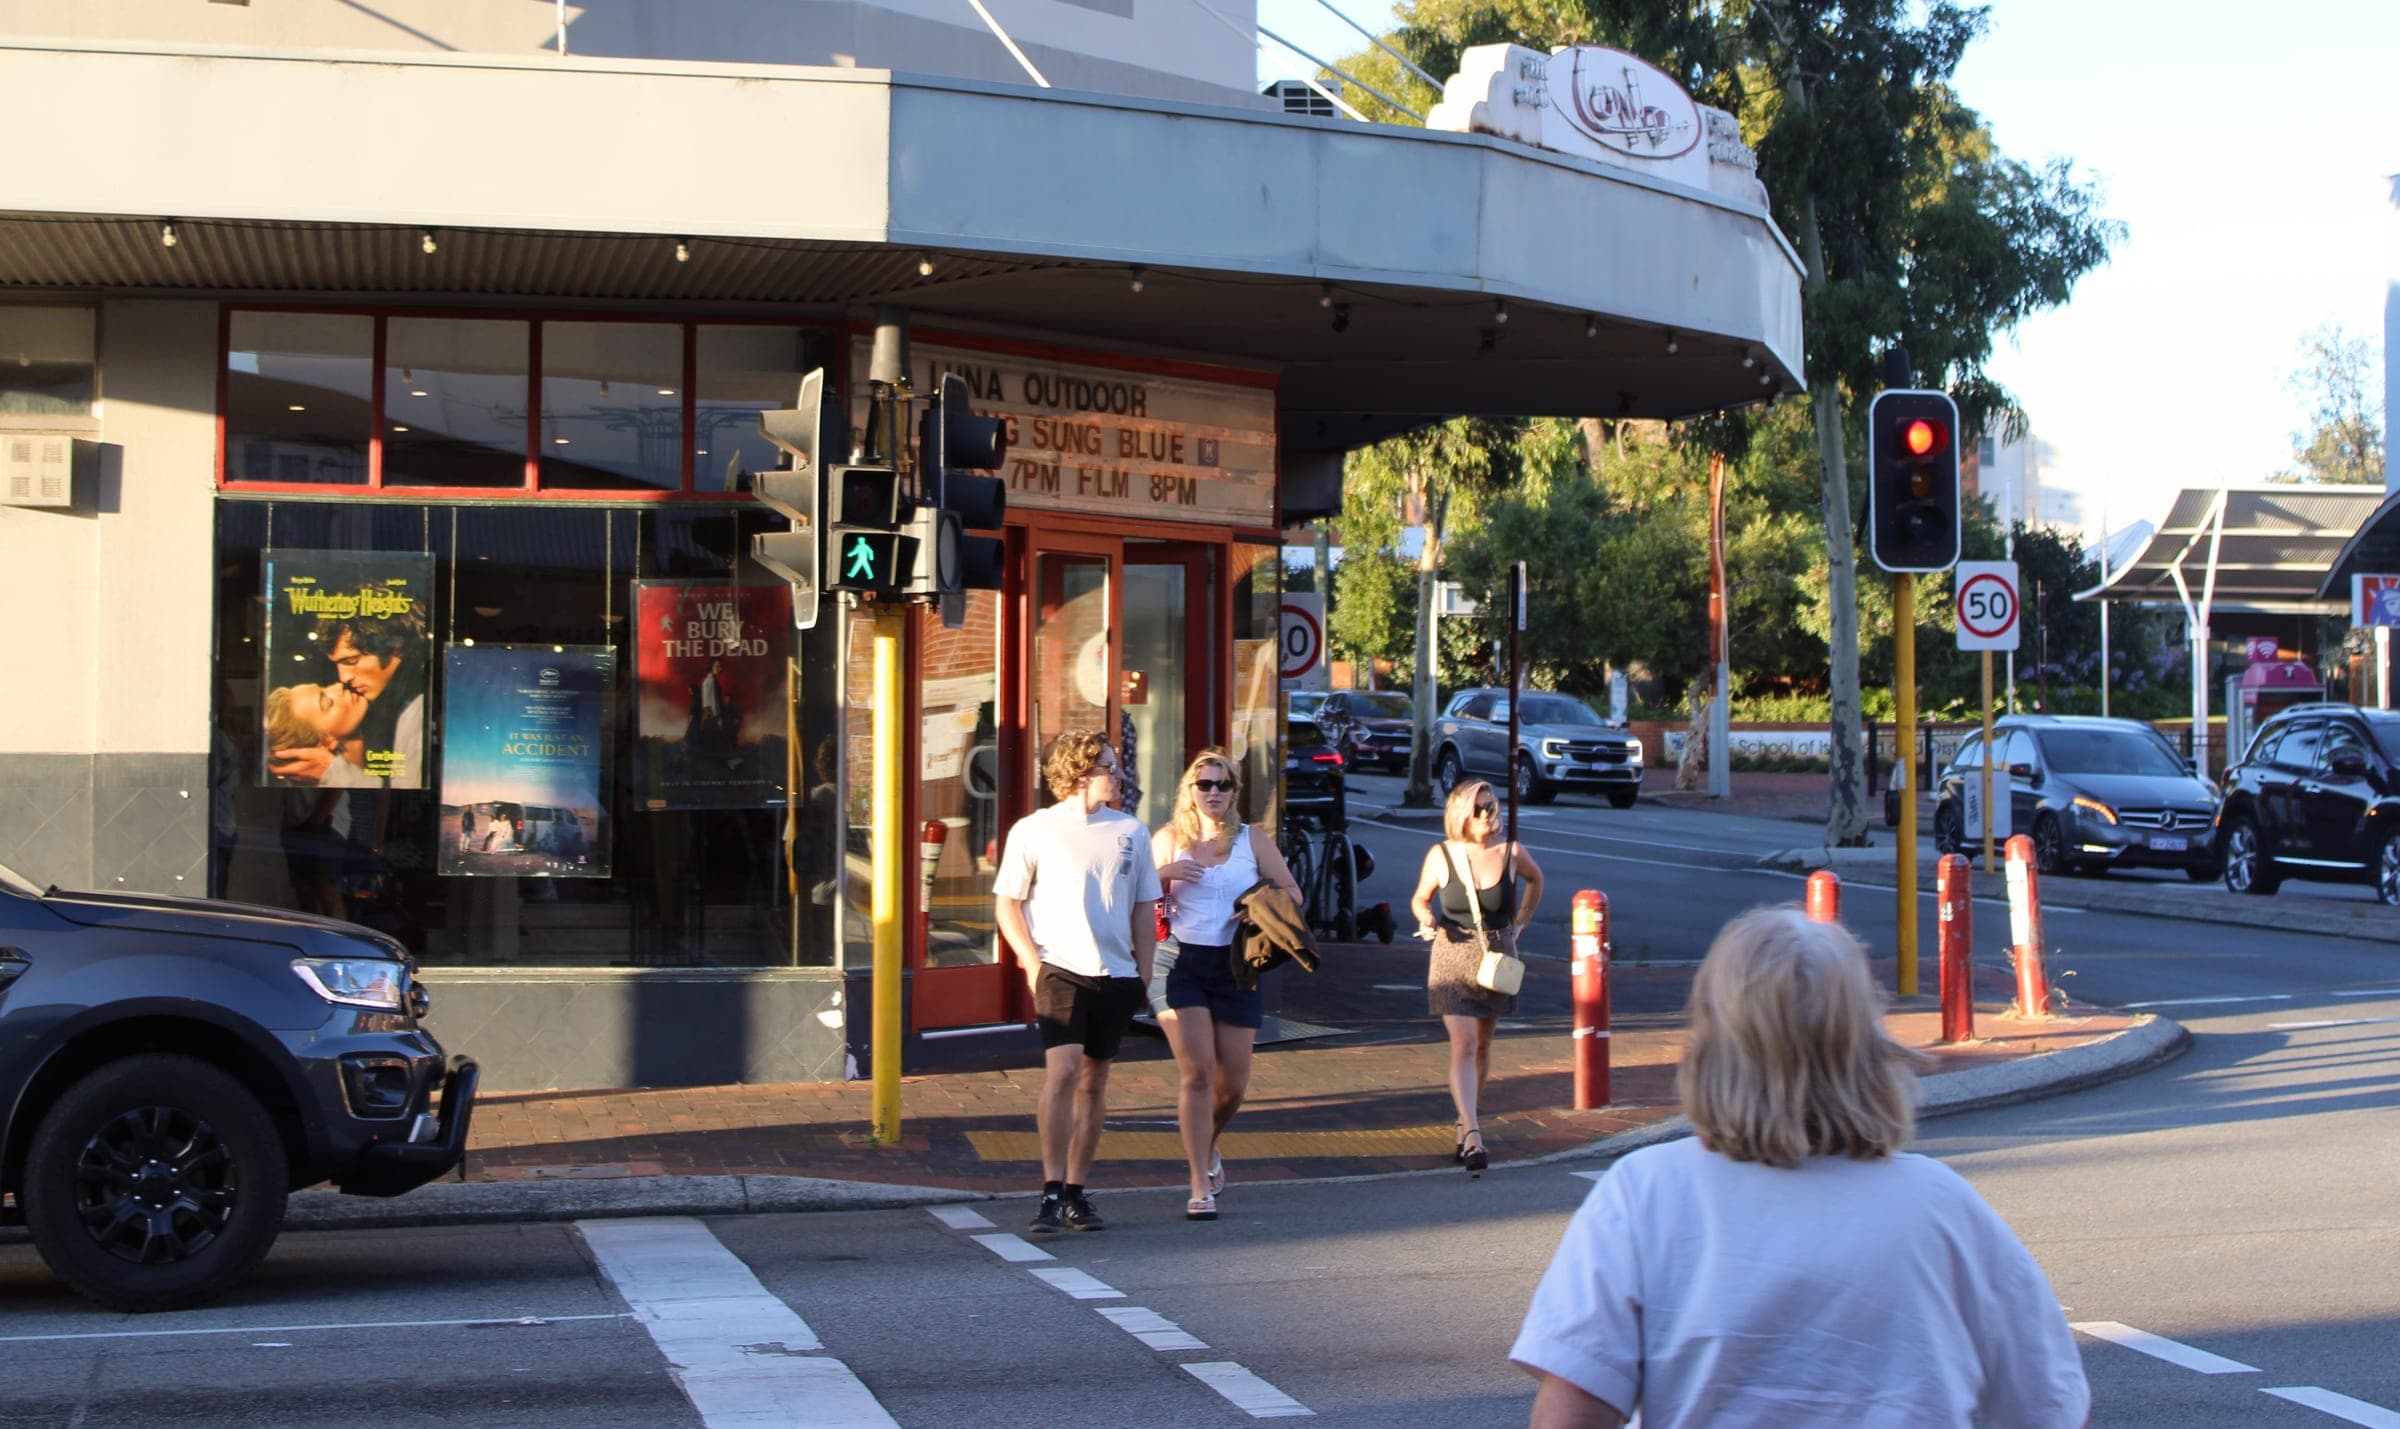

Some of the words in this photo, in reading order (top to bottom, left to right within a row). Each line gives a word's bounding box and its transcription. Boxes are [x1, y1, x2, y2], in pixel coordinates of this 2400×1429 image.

[929, 361, 1004, 402] LNA
[1023, 372, 1147, 418] OUTDOOR
[1031, 418, 1101, 456] SUNG
[1119, 428, 1186, 465] BLUE
[1008, 457, 1060, 493] 7PM
[1078, 464, 1130, 500] FLM
[1149, 473, 1198, 507] 8PM
[283, 586, 361, 619] Wuthering
[359, 587, 413, 620] Heights
[697, 602, 735, 620] WE
[1968, 592, 2008, 620] 50
[687, 621, 745, 639] BURY
[662, 639, 705, 657] THE
[709, 639, 769, 657] DEAD
[502, 742, 591, 757] ACCIDENT
[1738, 737, 1794, 755] School
[1798, 738, 1816, 755] of
